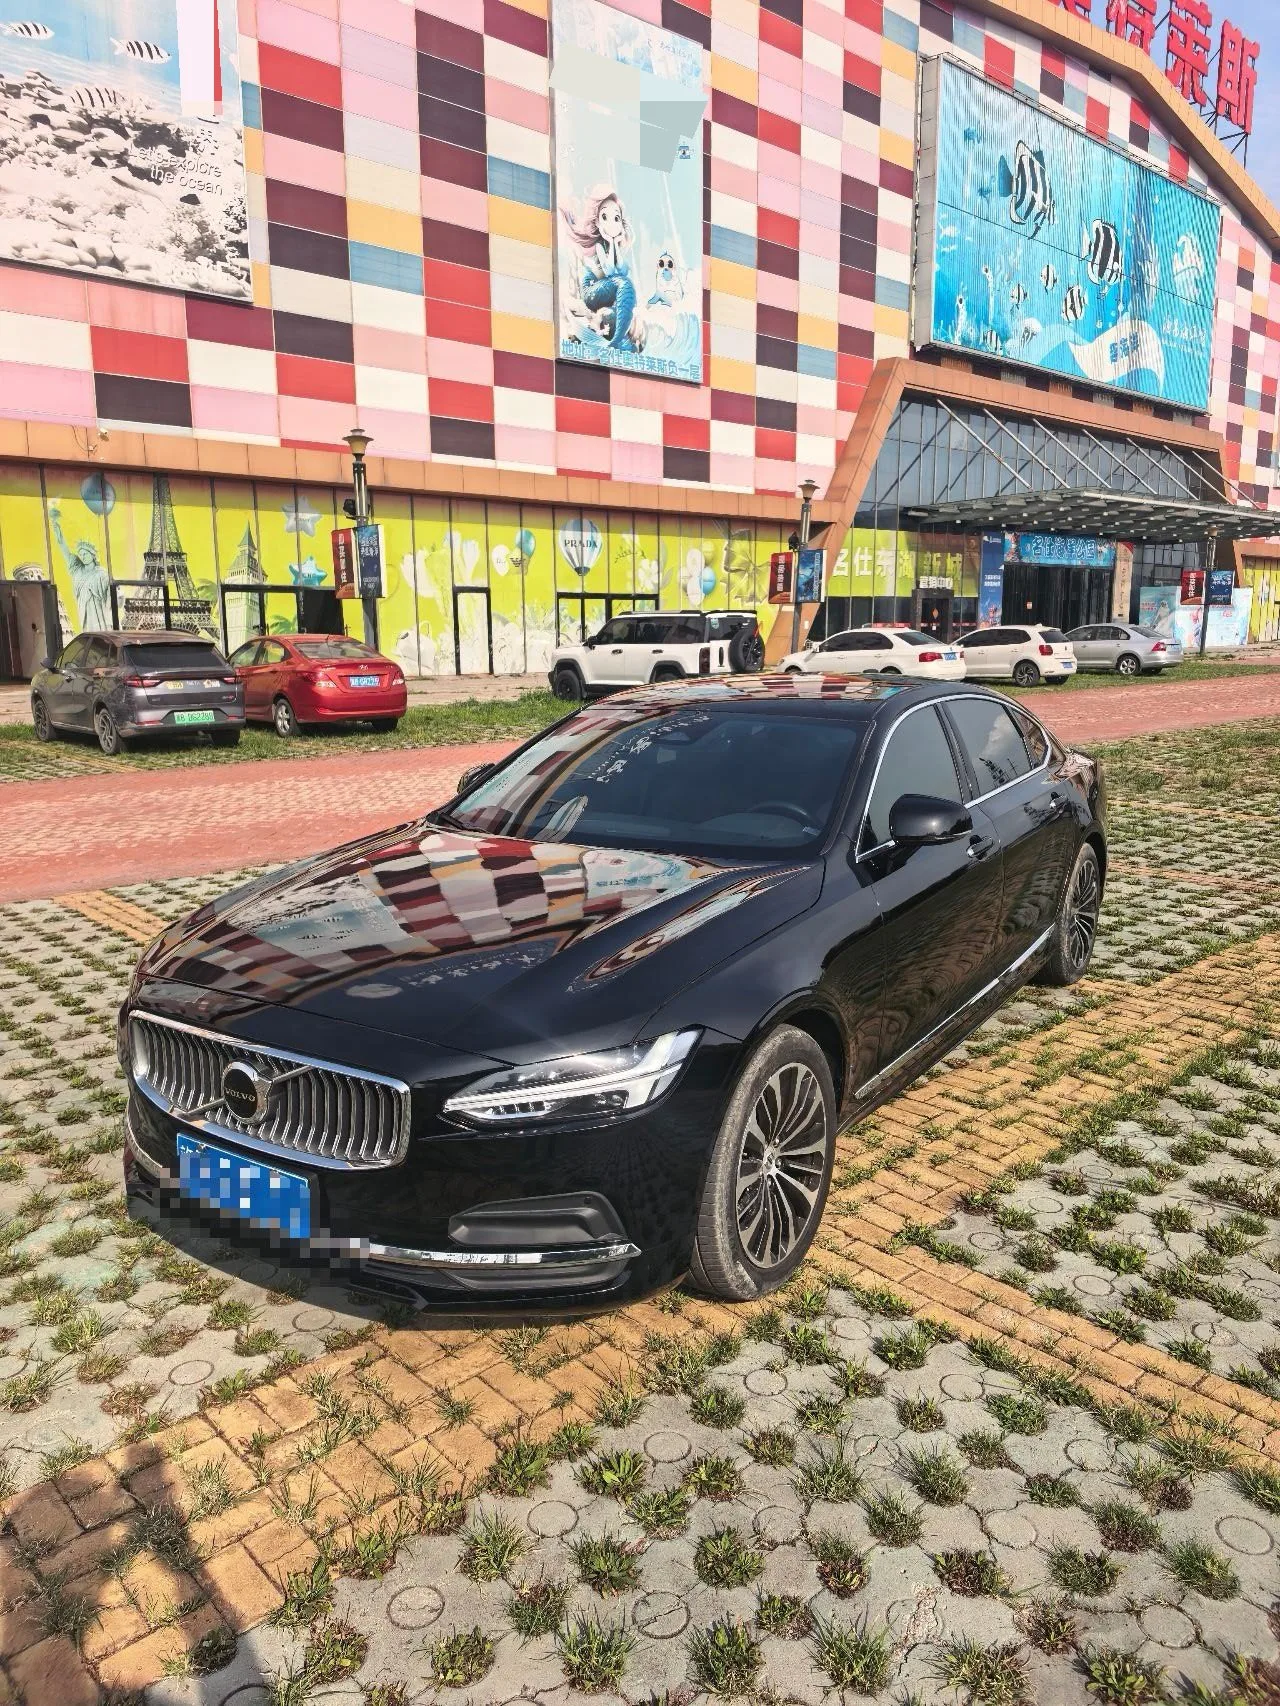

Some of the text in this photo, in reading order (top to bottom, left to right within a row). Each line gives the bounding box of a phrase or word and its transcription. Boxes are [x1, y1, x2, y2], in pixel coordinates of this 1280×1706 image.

[169, 156, 222, 178] explore
[150, 165, 223, 195] the ocean
[563, 538, 598, 549] PRADA
[225, 1087, 256, 1102] VOLVO
